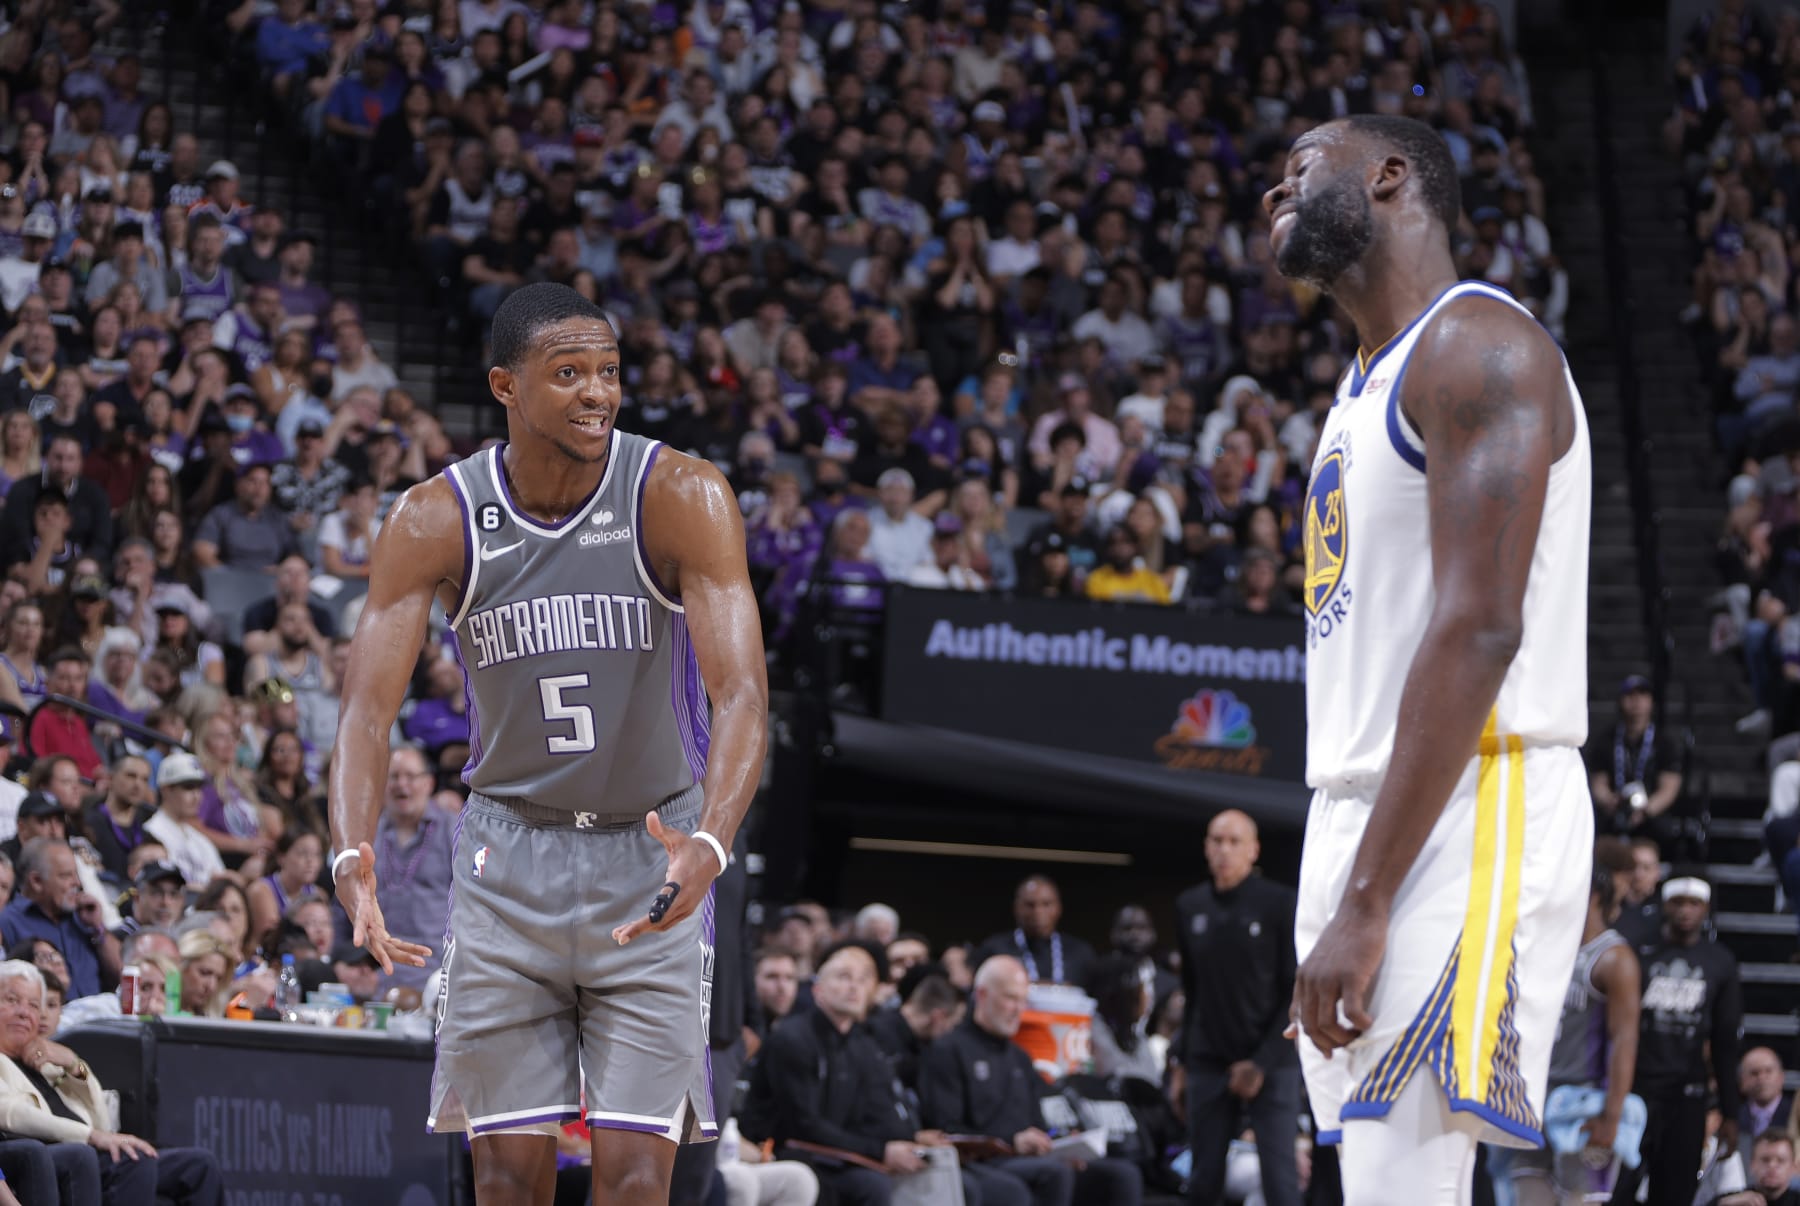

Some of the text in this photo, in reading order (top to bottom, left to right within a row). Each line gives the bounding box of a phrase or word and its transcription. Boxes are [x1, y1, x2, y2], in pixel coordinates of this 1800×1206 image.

[482, 506, 499, 530] 6
[579, 526, 631, 547] dialpad
[1322, 488, 1341, 537] 23
[467, 593, 653, 670] SACRAMENTO
[925, 619, 1127, 671] Authentic
[537, 672, 597, 755] 5
[316, 1101, 393, 1178] HAWKS
